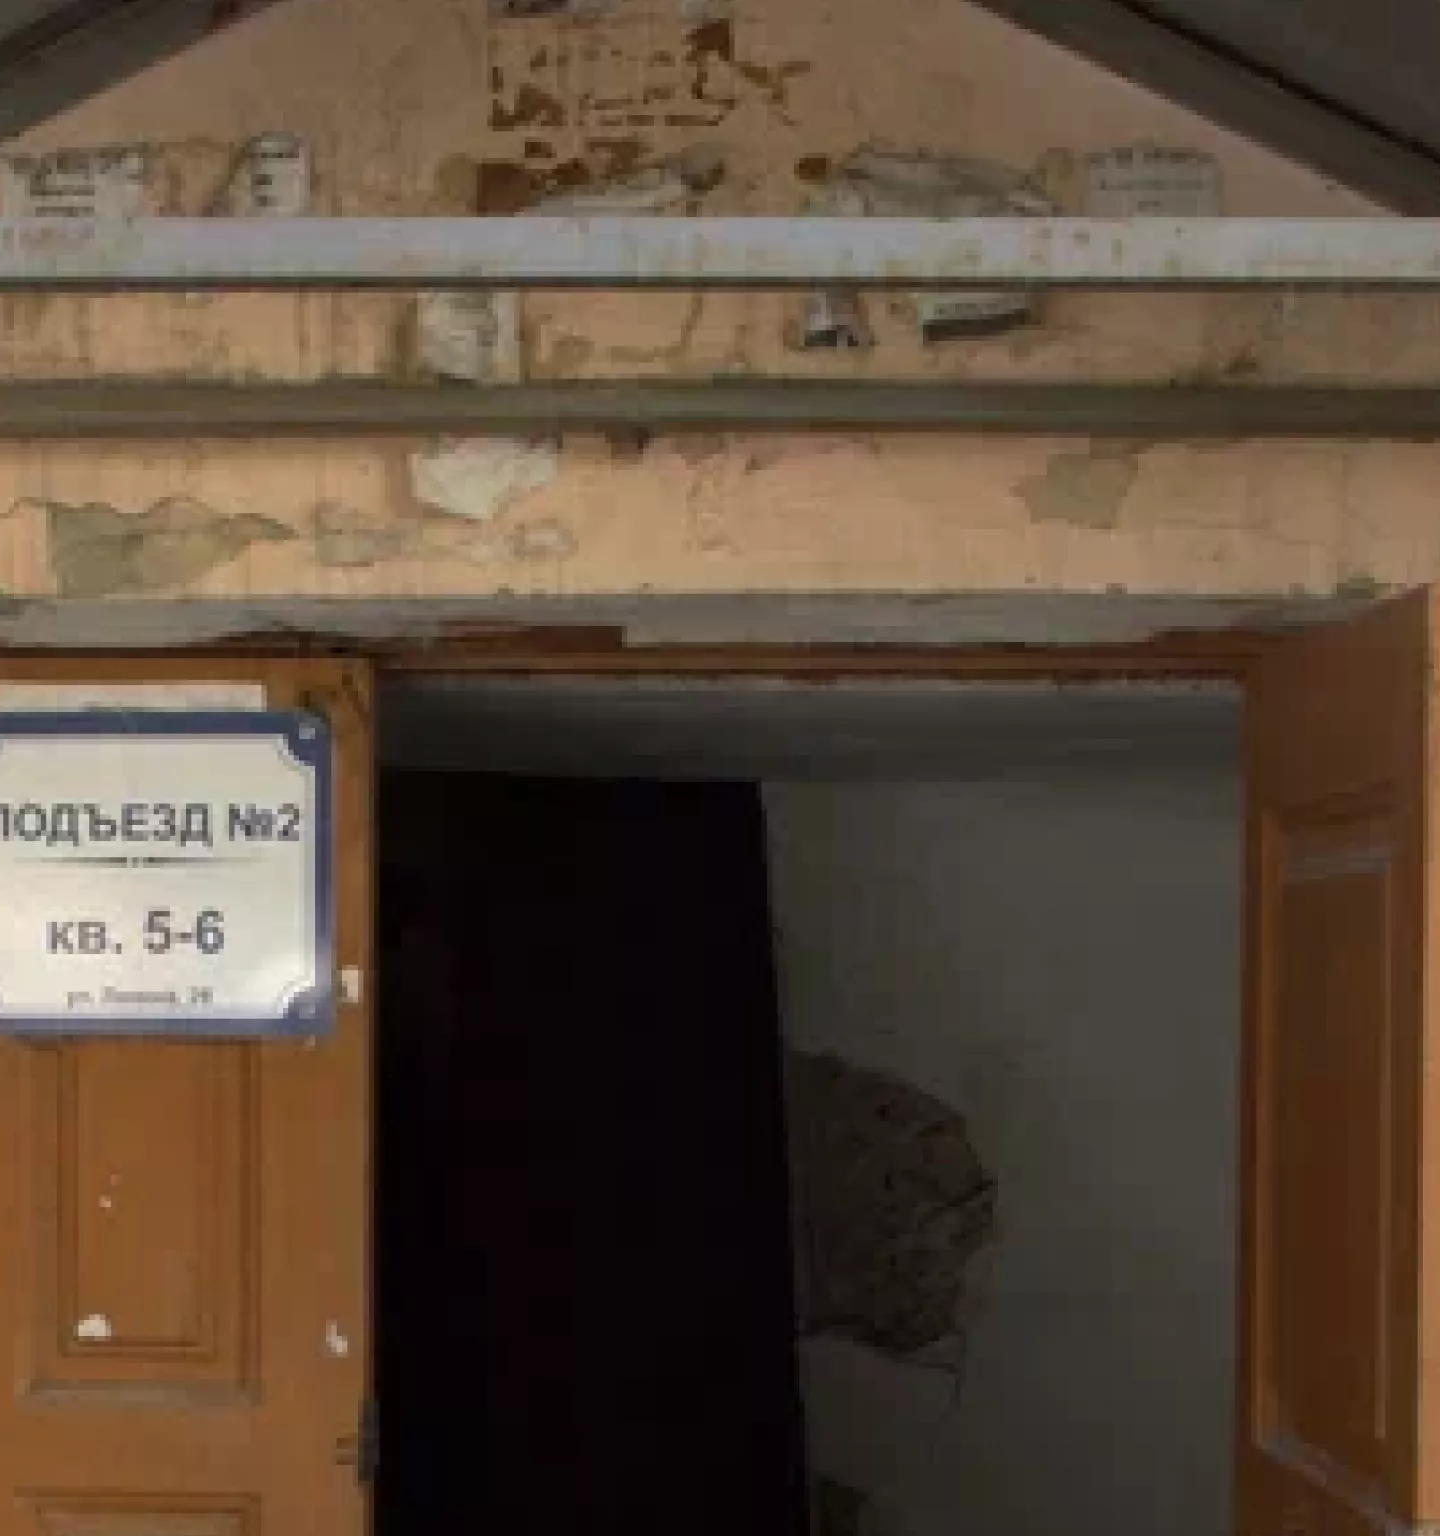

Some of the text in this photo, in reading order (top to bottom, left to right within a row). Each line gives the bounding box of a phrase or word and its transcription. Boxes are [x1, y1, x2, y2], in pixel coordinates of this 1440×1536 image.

[228, 802, 300, 842] №2
[46, 909, 225, 955] кв. 5-6
